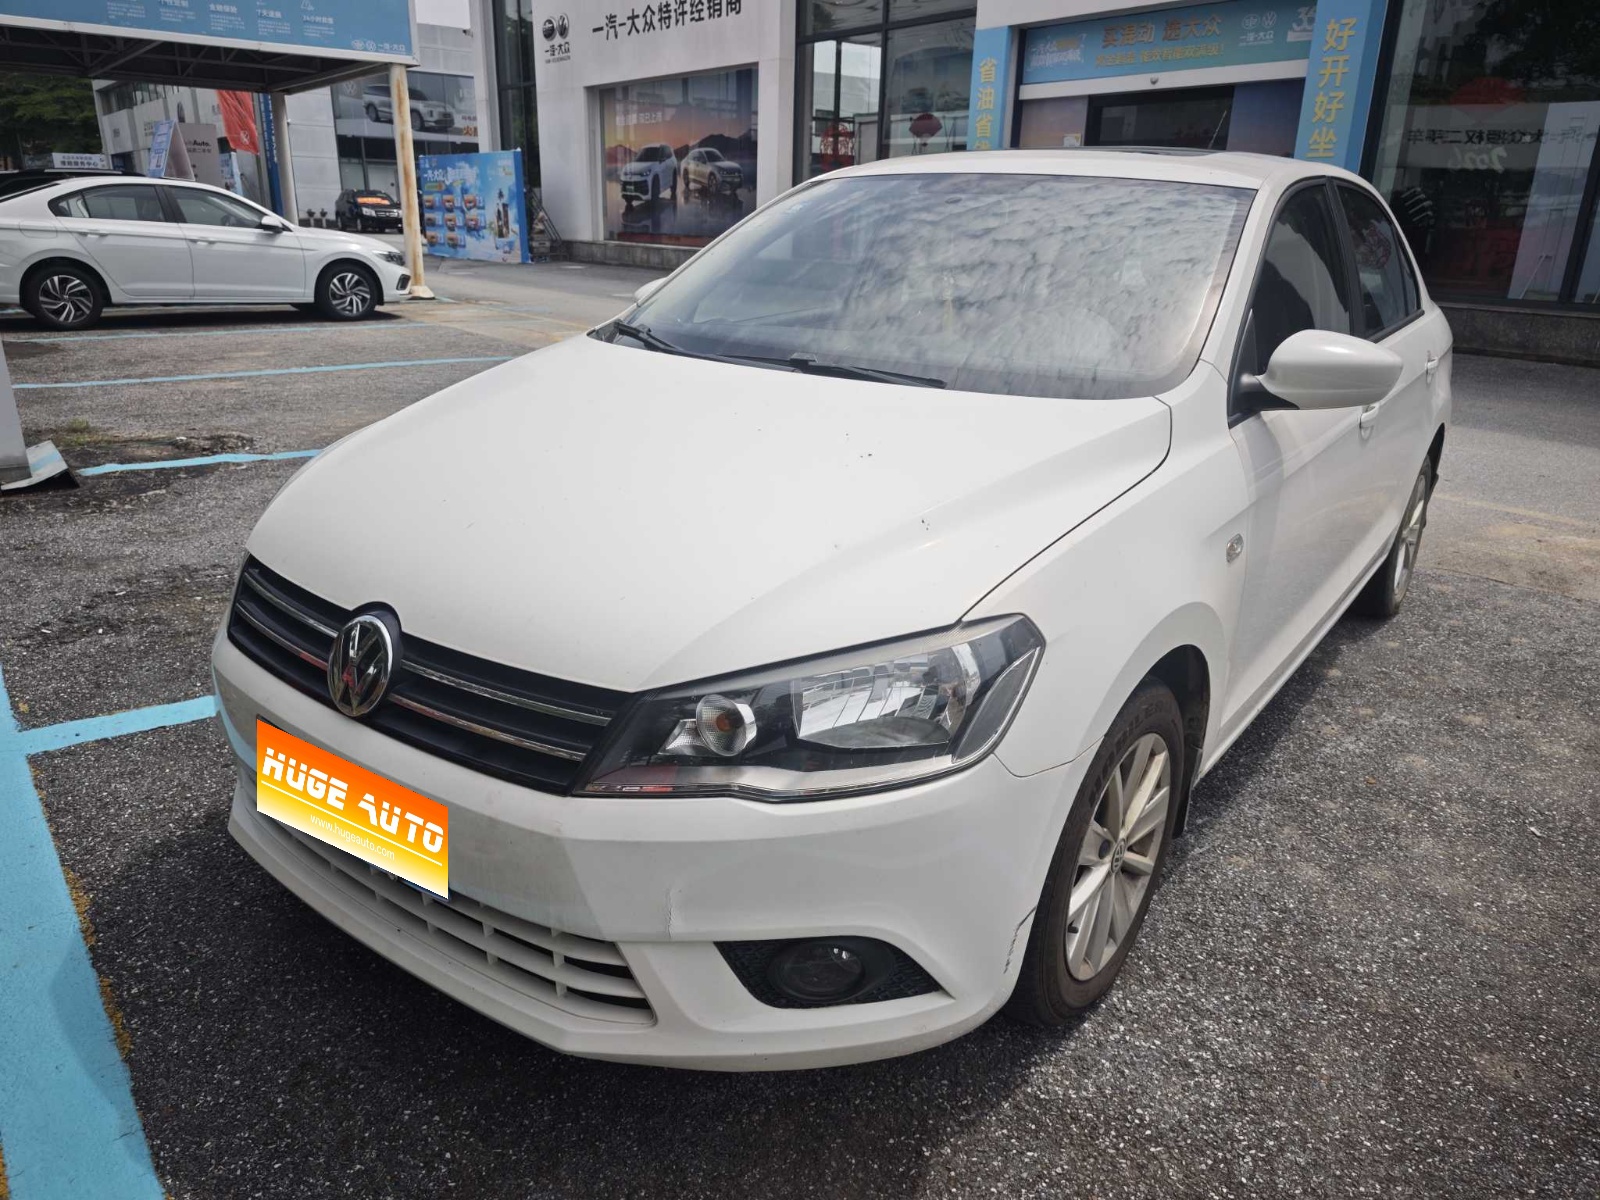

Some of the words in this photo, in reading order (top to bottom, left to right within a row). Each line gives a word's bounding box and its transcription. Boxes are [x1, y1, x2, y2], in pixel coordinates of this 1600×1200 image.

[592, 0, 742, 41] 一汽-大众特许经销商
[1304, 17, 1357, 157] 好开好坐
